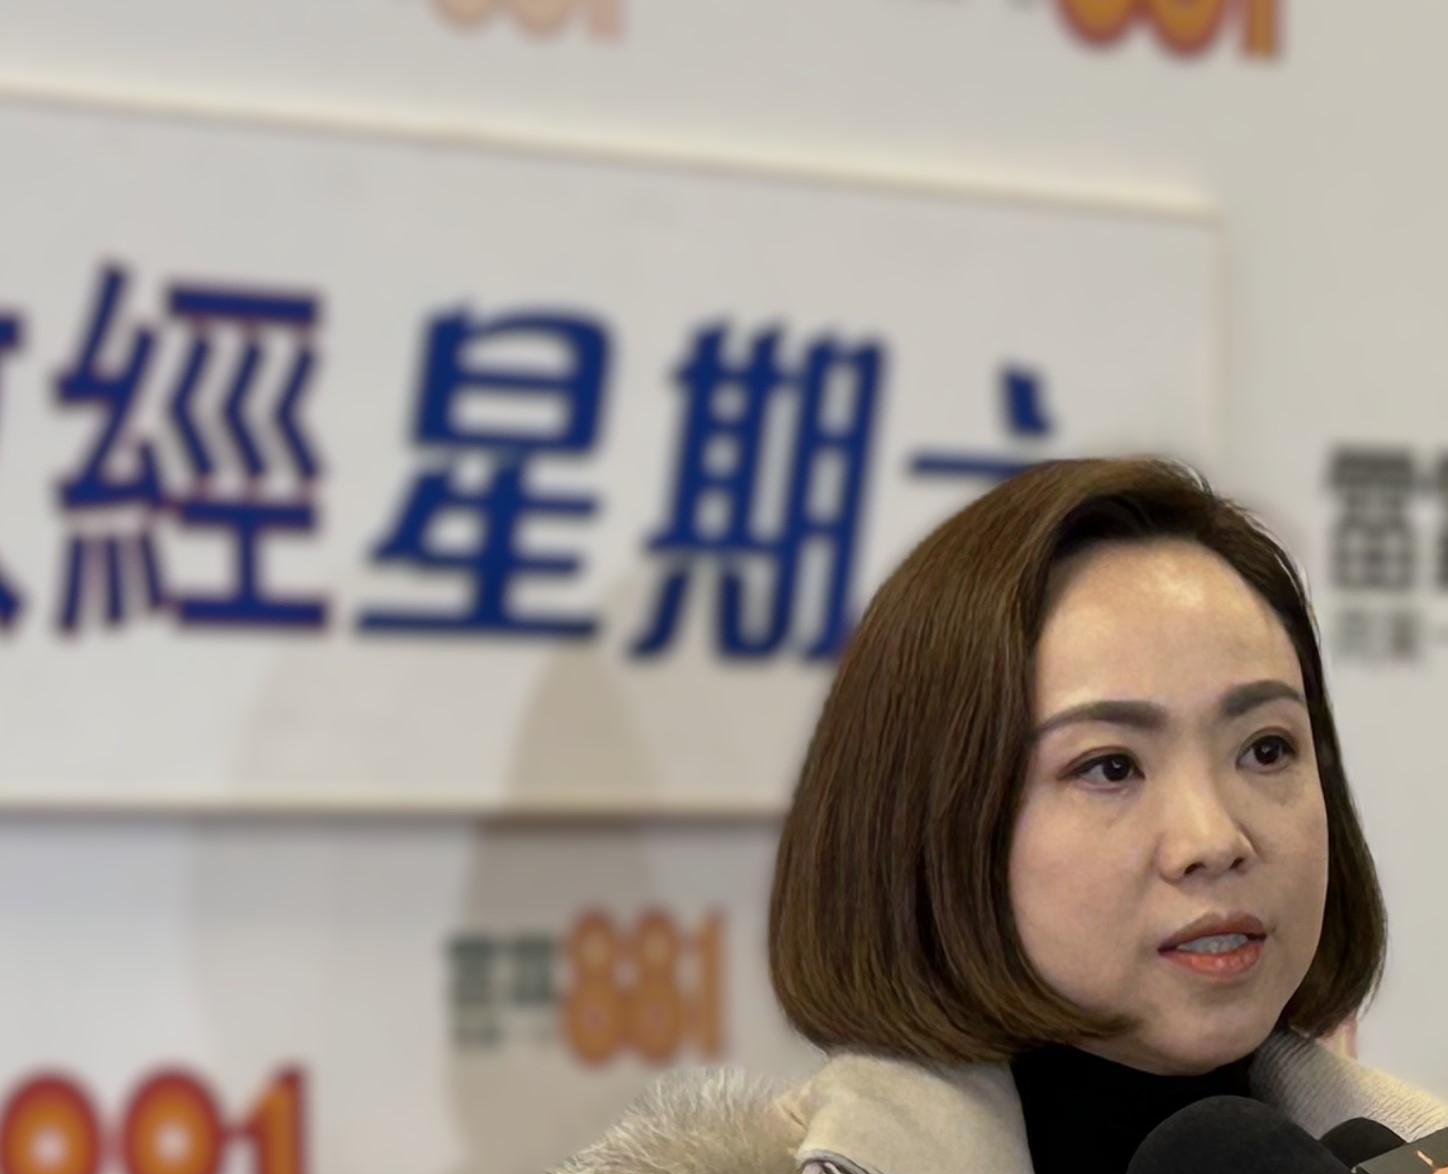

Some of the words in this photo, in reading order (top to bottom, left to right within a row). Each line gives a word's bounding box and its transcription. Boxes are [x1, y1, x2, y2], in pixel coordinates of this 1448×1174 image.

[0, 260, 1055, 667] 經星期
[562, 906, 726, 1070] 881
